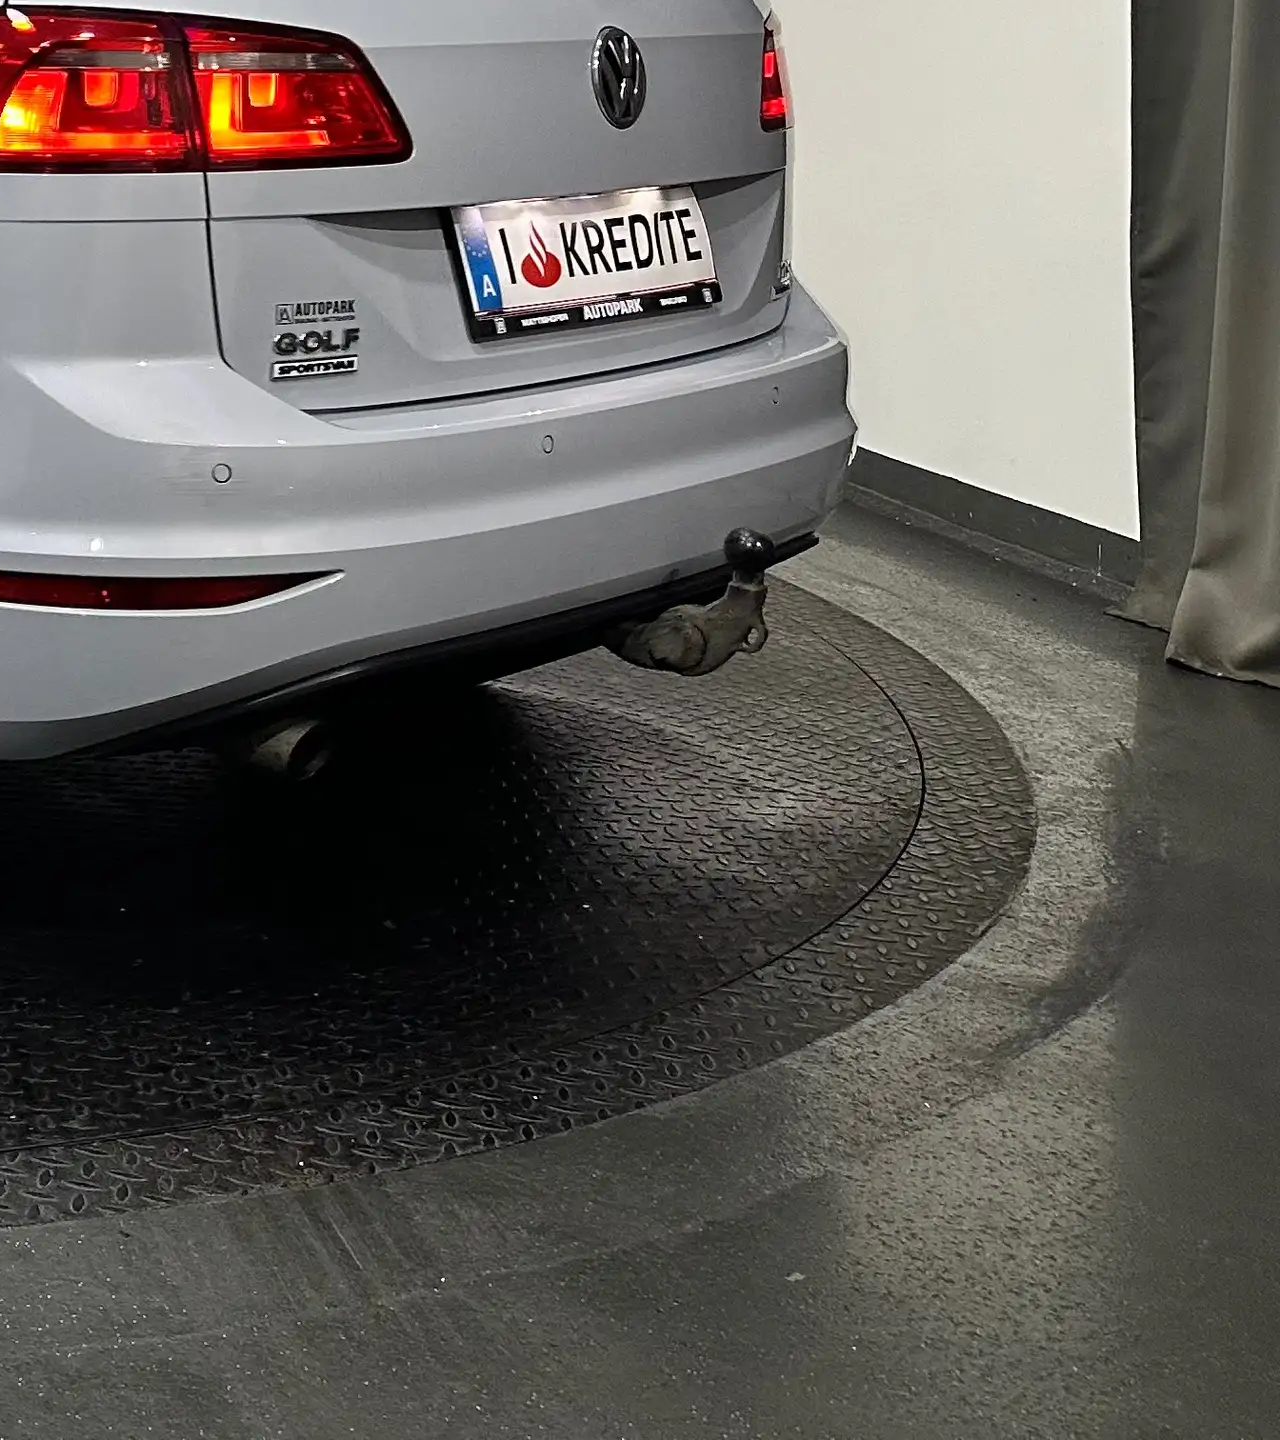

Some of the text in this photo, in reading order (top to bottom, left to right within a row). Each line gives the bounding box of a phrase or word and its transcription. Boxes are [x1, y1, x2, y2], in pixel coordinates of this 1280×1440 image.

[497, 227, 518, 285] I
[558, 207, 704, 278] KREDITE
[481, 273, 497, 298] A
[294, 299, 357, 316] AUTOPARK
[583, 297, 644, 321] AUTOPARK
[272, 327, 361, 356] GOLF
